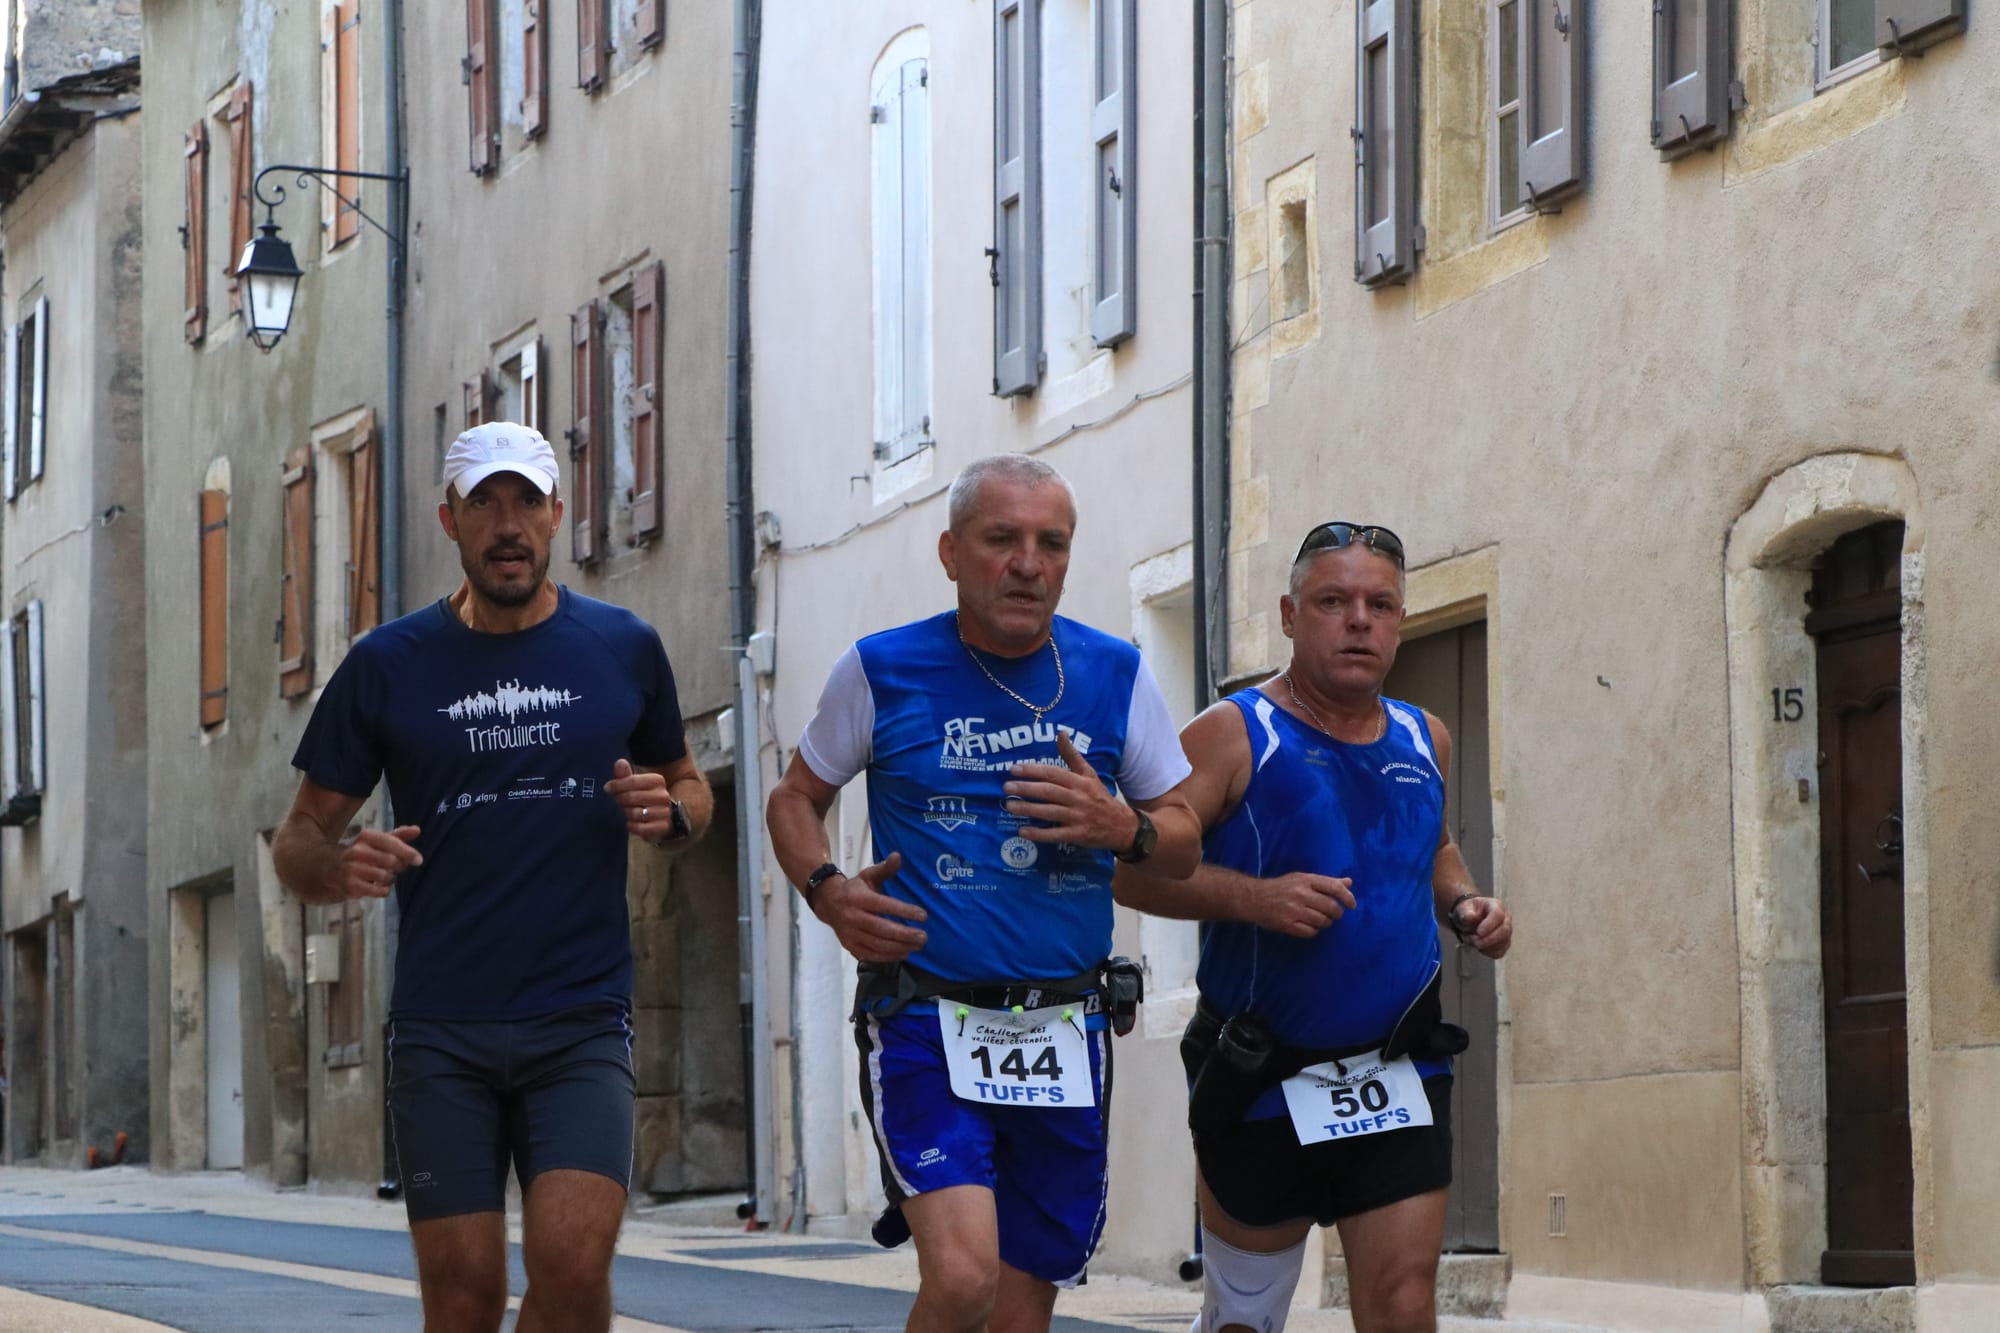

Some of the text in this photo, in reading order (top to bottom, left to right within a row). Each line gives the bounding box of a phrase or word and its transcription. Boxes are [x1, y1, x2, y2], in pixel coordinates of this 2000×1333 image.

[1771, 687, 1804, 722] 15
[465, 721, 561, 752] Trifouillette
[1380, 762, 1430, 779] MACADAM CLUB
[936, 853, 975, 882] Centre
[970, 1045, 1063, 1082] 144
[974, 1082, 1065, 1103] TUFF'S
[1330, 1079, 1389, 1118] 50
[1323, 1107, 1411, 1137] TUFF'S
